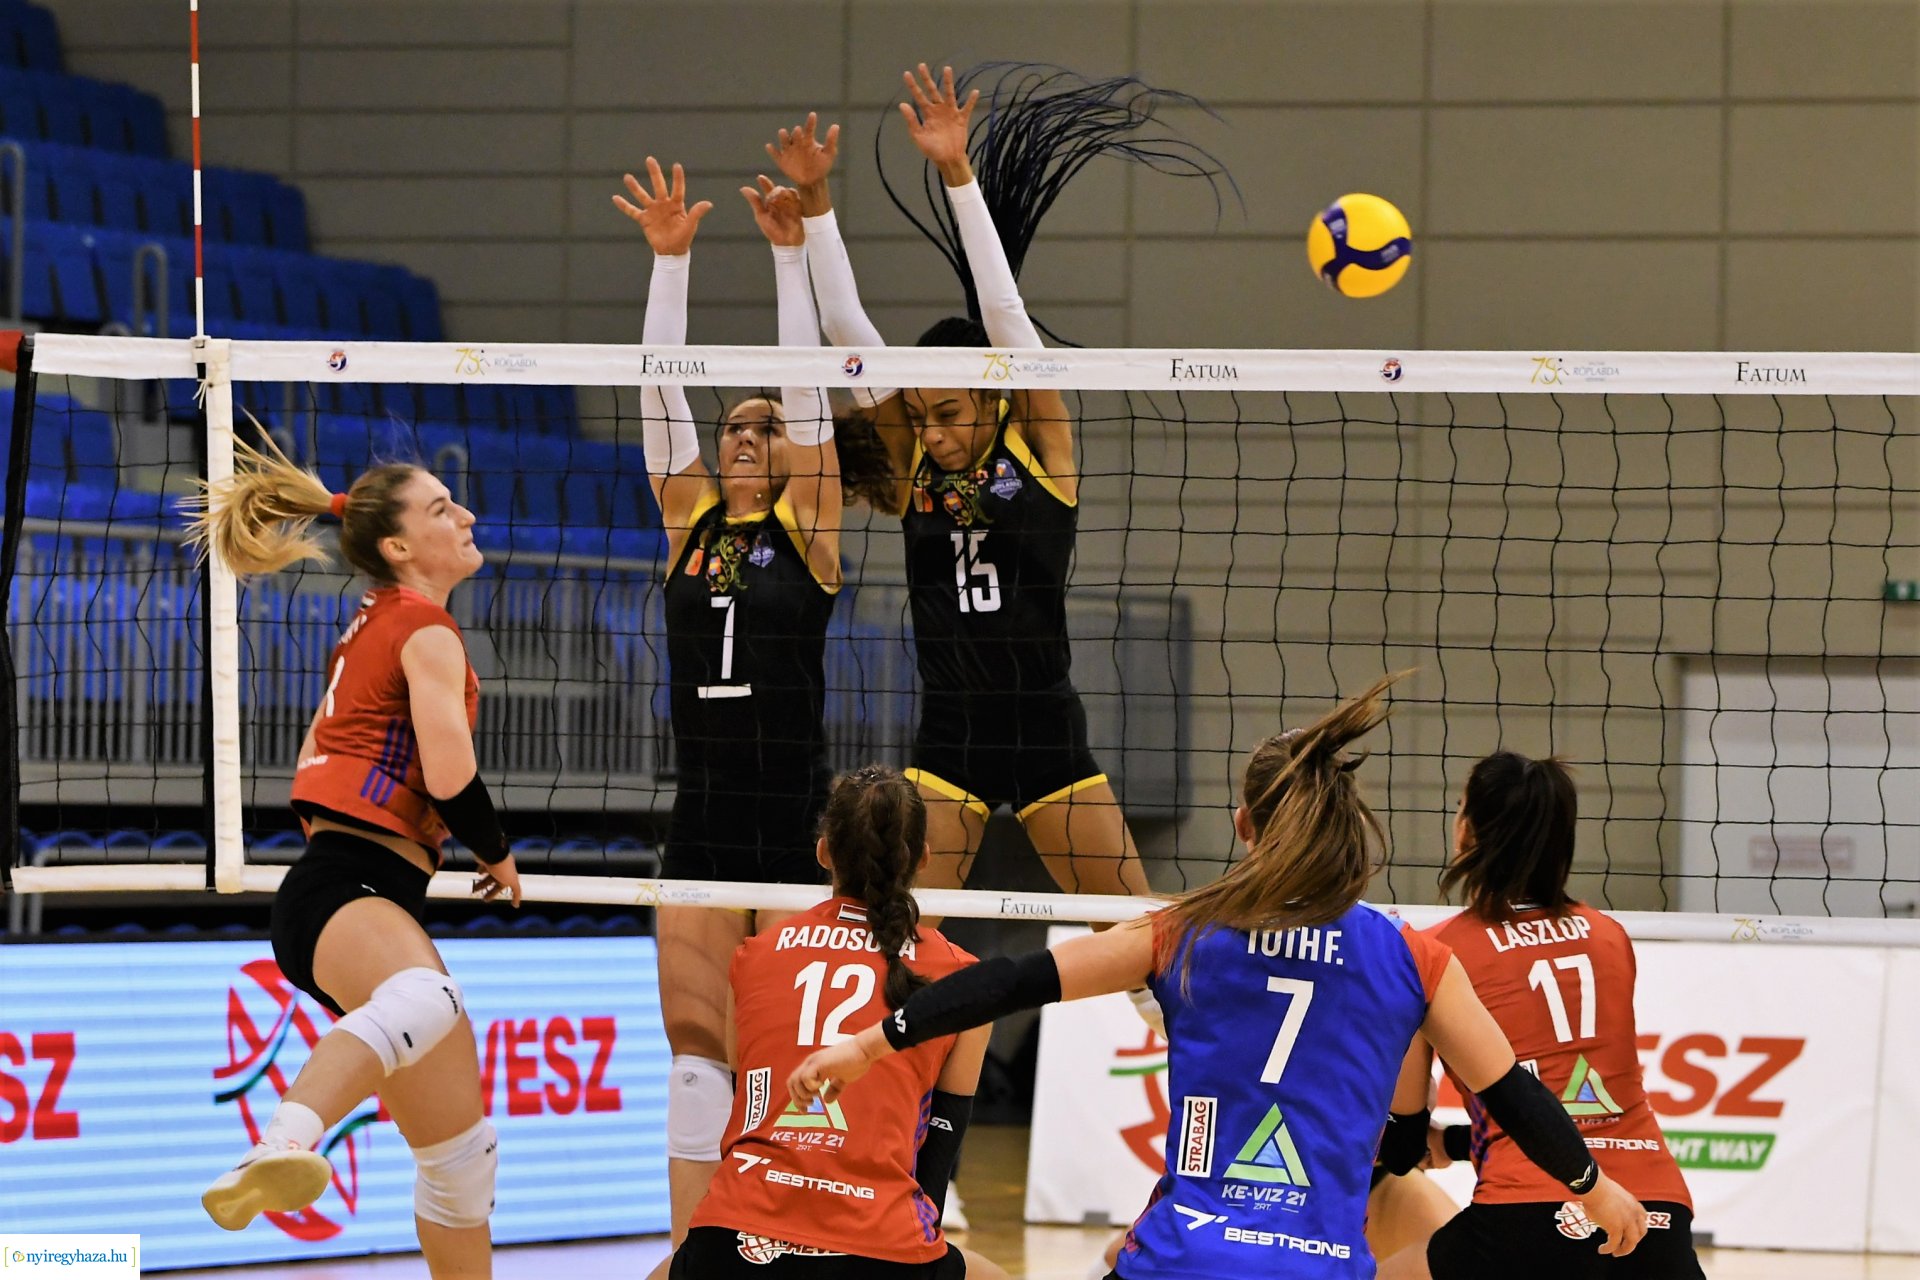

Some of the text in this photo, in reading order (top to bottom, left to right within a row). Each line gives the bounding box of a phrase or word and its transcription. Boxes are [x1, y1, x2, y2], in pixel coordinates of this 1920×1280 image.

[950, 530, 1002, 613] 15
[793, 960, 876, 1047] 12
[1527, 953, 1597, 1043] 17
[1259, 976, 1314, 1084] 7
[751, 1072, 764, 1128] TRABAG
[769, 1131, 846, 1148] KE-VIZ 21
[1188, 1101, 1207, 1172] STRABAG
[1583, 1137, 1660, 1151] ESTRONG
[1665, 1136, 1768, 1164] HT WAY
[765, 1169, 875, 1200] BESTRONG
[1221, 1184, 1308, 1207] KE-VIZ 21
[1224, 1226, 1351, 1260] BESTRONG
